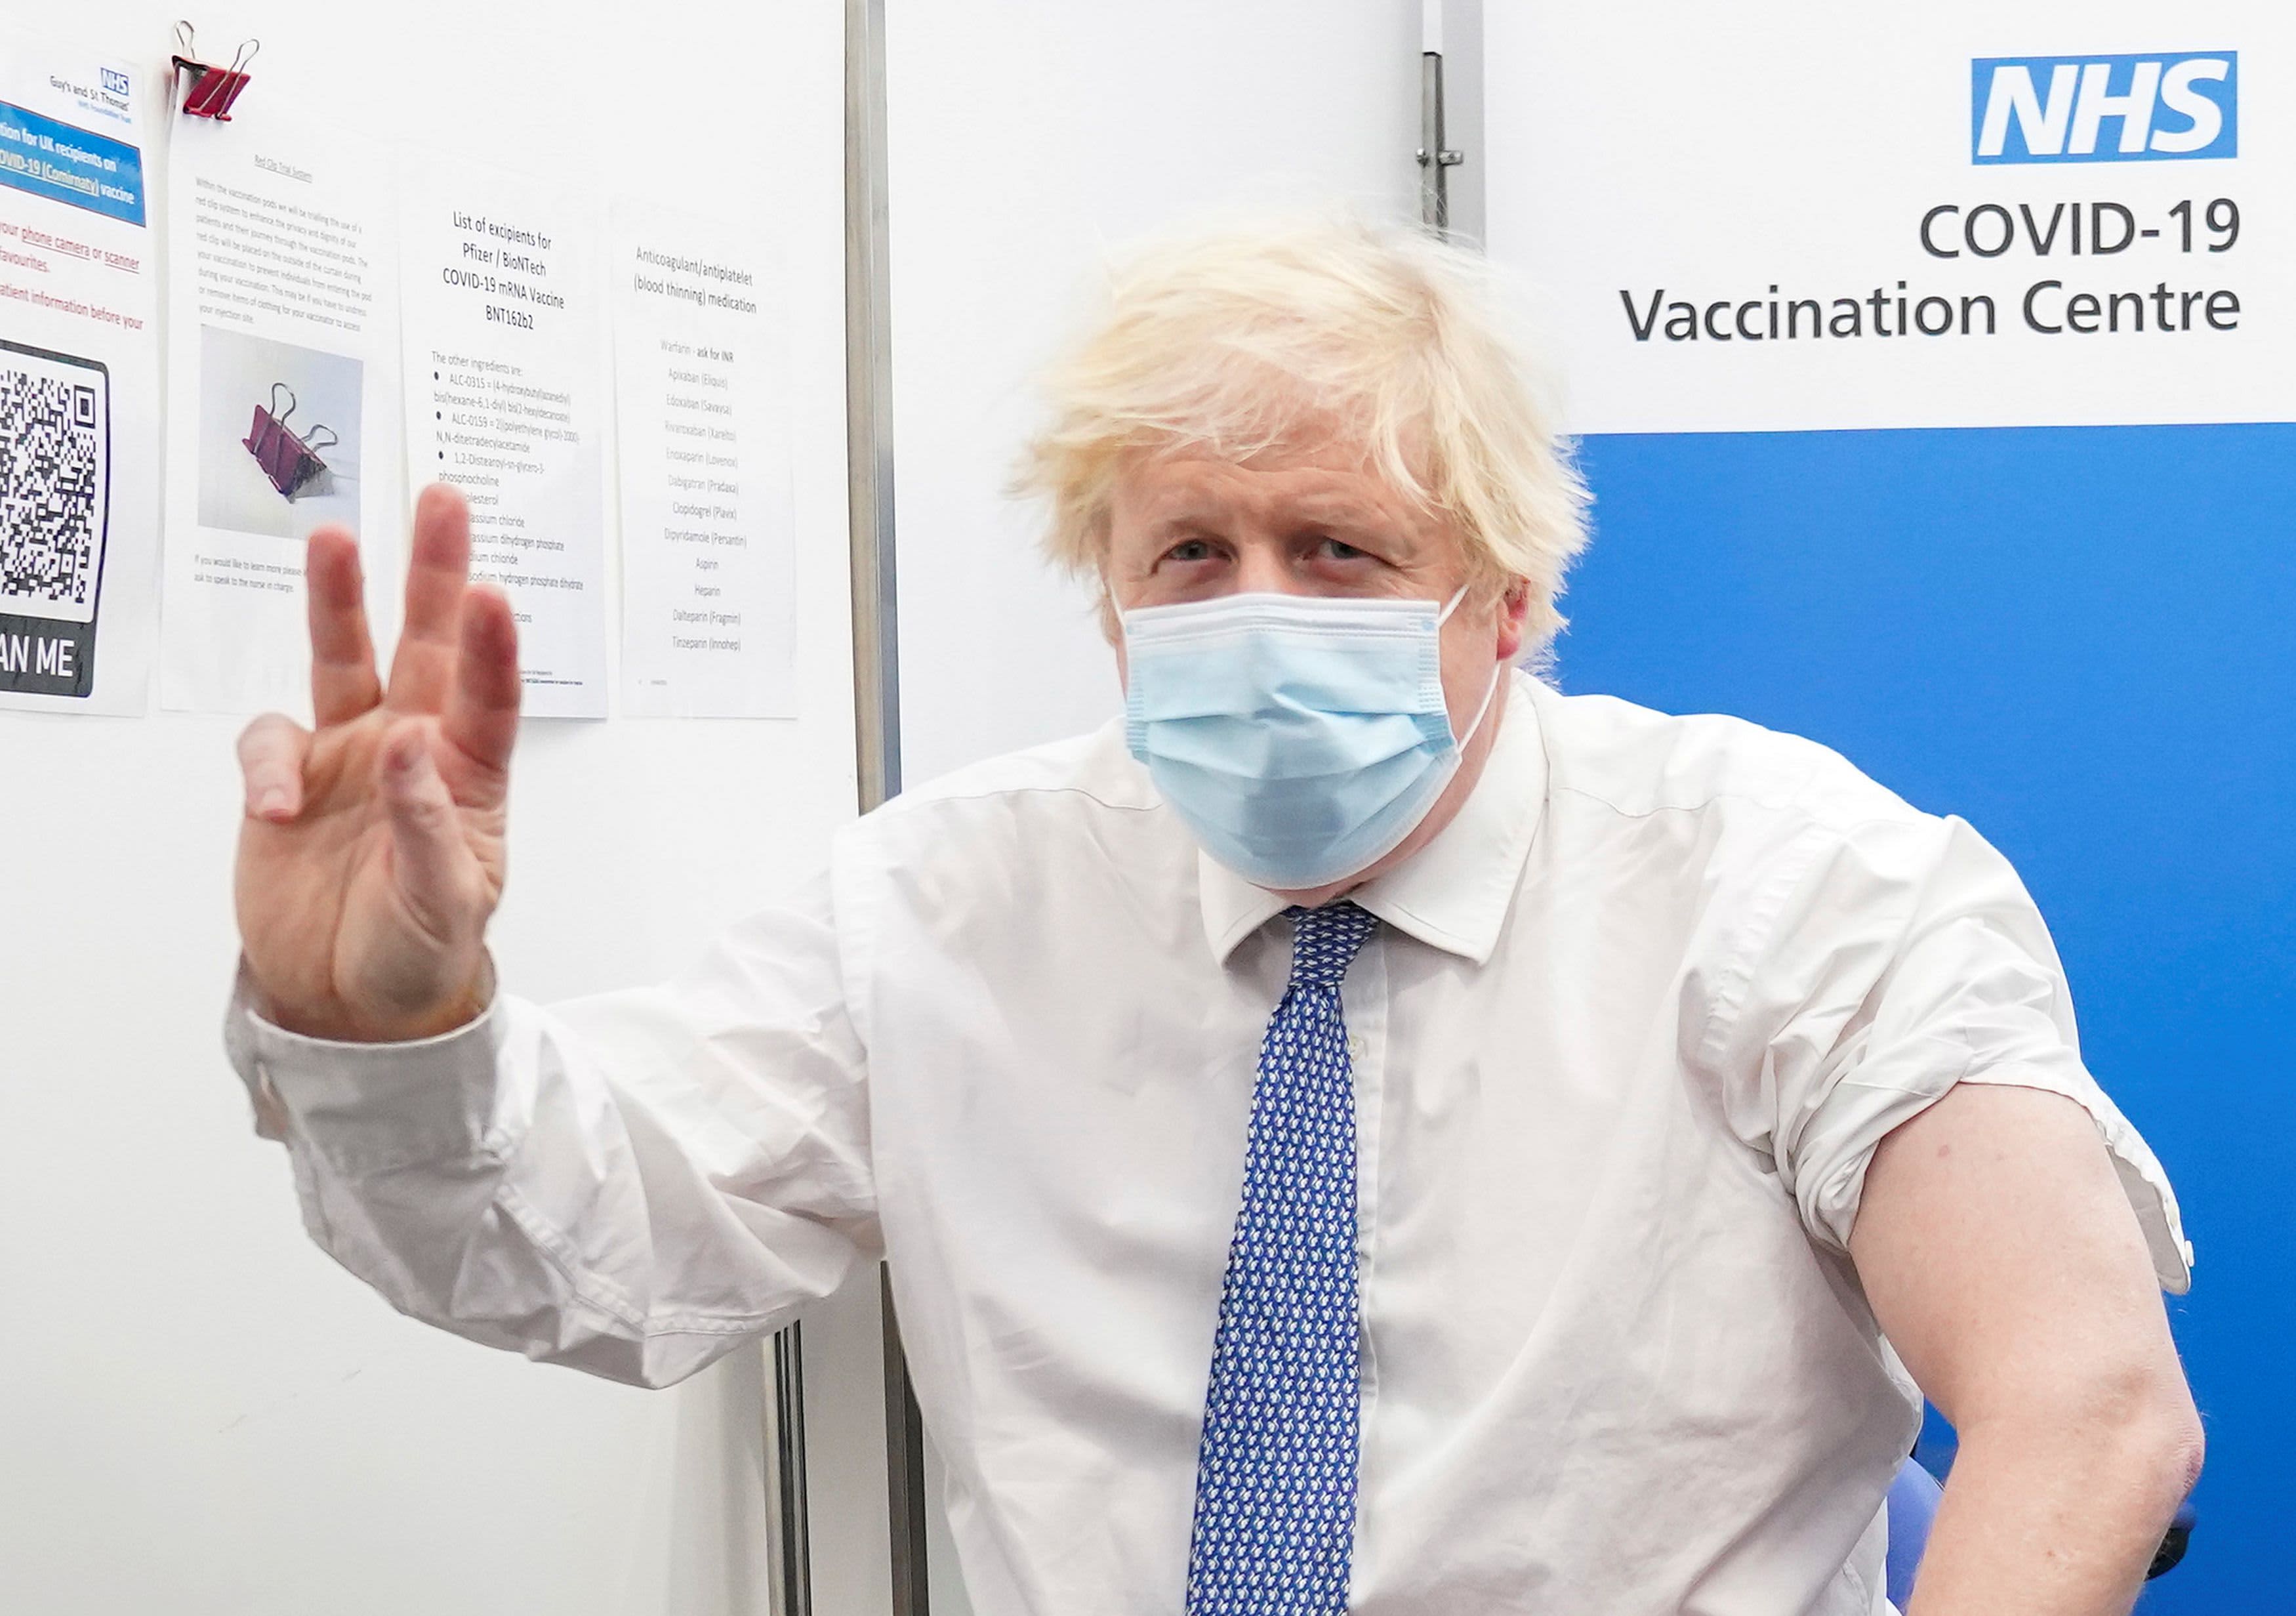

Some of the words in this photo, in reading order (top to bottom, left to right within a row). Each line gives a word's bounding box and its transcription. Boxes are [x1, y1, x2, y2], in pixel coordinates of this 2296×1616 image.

[50, 75, 71, 93] Guy's
[73, 85, 88, 98] and
[101, 69, 129, 95] NHS
[1977, 58, 2229, 157] NHS
[22, 128, 37, 146] for
[39, 134, 54, 152] UK
[55, 143, 102, 168] recipients
[104, 159, 116, 172] on
[43, 162, 98, 195] (Comirnaty)
[100, 184, 134, 204] vaccine
[453, 211, 472, 230] List
[476, 217, 486, 233] of
[489, 222, 535, 247] excipients
[538, 232, 551, 250] for
[1919, 197, 2241, 259] COVID-19
[22, 226, 52, 246] phone
[54, 238, 90, 256] camera
[92, 248, 102, 259] or
[104, 252, 140, 270] scanner
[462, 243, 493, 263] Pfizer
[496, 249, 500, 268] /
[503, 252, 546, 276] BioNTech
[636, 246, 753, 287] Anticoagulant/antiplatelet
[443, 268, 496, 293] COVID-19
[499, 281, 527, 300] mRNA
[529, 287, 564, 309] Vaccine
[634, 273, 663, 294] (blood
[666, 280, 706, 307] thinning)
[708, 293, 756, 314] medication
[31, 291, 89, 316] information
[91, 305, 121, 325] before
[123, 316, 144, 329] your
[485, 305, 534, 329] BNT162b2
[1620, 280, 1996, 341] Vaccination
[2021, 279, 2241, 335] Centre
[432, 351, 446, 364] The
[448, 355, 468, 367] other
[471, 358, 510, 374] ingredients
[660, 339, 691, 355] Warfarin
[697, 346, 708, 358] ask
[710, 348, 720, 361] for
[722, 351, 734, 363] INR
[449, 373, 485, 388] ALC-0315
[668, 368, 700, 384] Apixaban
[701, 372, 728, 390] (Eliquis)
[666, 393, 699, 409] Edoxaban
[452, 413, 487, 428] ALC-0159
[665, 420, 706, 436] Rivaroxaban
[666, 446, 704, 463] Enoxaparin
[439, 471, 499, 487] phosphocholine
[668, 474, 705, 491] Dabigatran
[707, 479, 739, 497] (Pradaxa)
[466, 493, 499, 505] olesterol
[672, 501, 711, 519] Clopidogrel
[712, 506, 737, 520] (Plavix)
[470, 514, 497, 524] assium
[499, 514, 525, 528] chloride
[472, 533, 499, 544] assium
[501, 534, 535, 549] dihydrogen
[536, 539, 564, 551] phosphate
[665, 528, 710, 543] Dipyridamole
[711, 531, 747, 549] (Persantin)
[491, 552, 518, 564] chloride
[695, 558, 719, 571] Aspirin
[469, 571, 499, 582] sodium
[499, 572, 529, 587] hydrogen
[530, 575, 558, 589] phosphate
[695, 585, 721, 598] Heparin
[672, 609, 708, 623] Dalteparin
[710, 611, 741, 626] (Fragmin)
[673, 636, 708, 650] Tinzeparin
[709, 638, 741, 652] (Innohep)
[35, 637, 75, 676] ME
